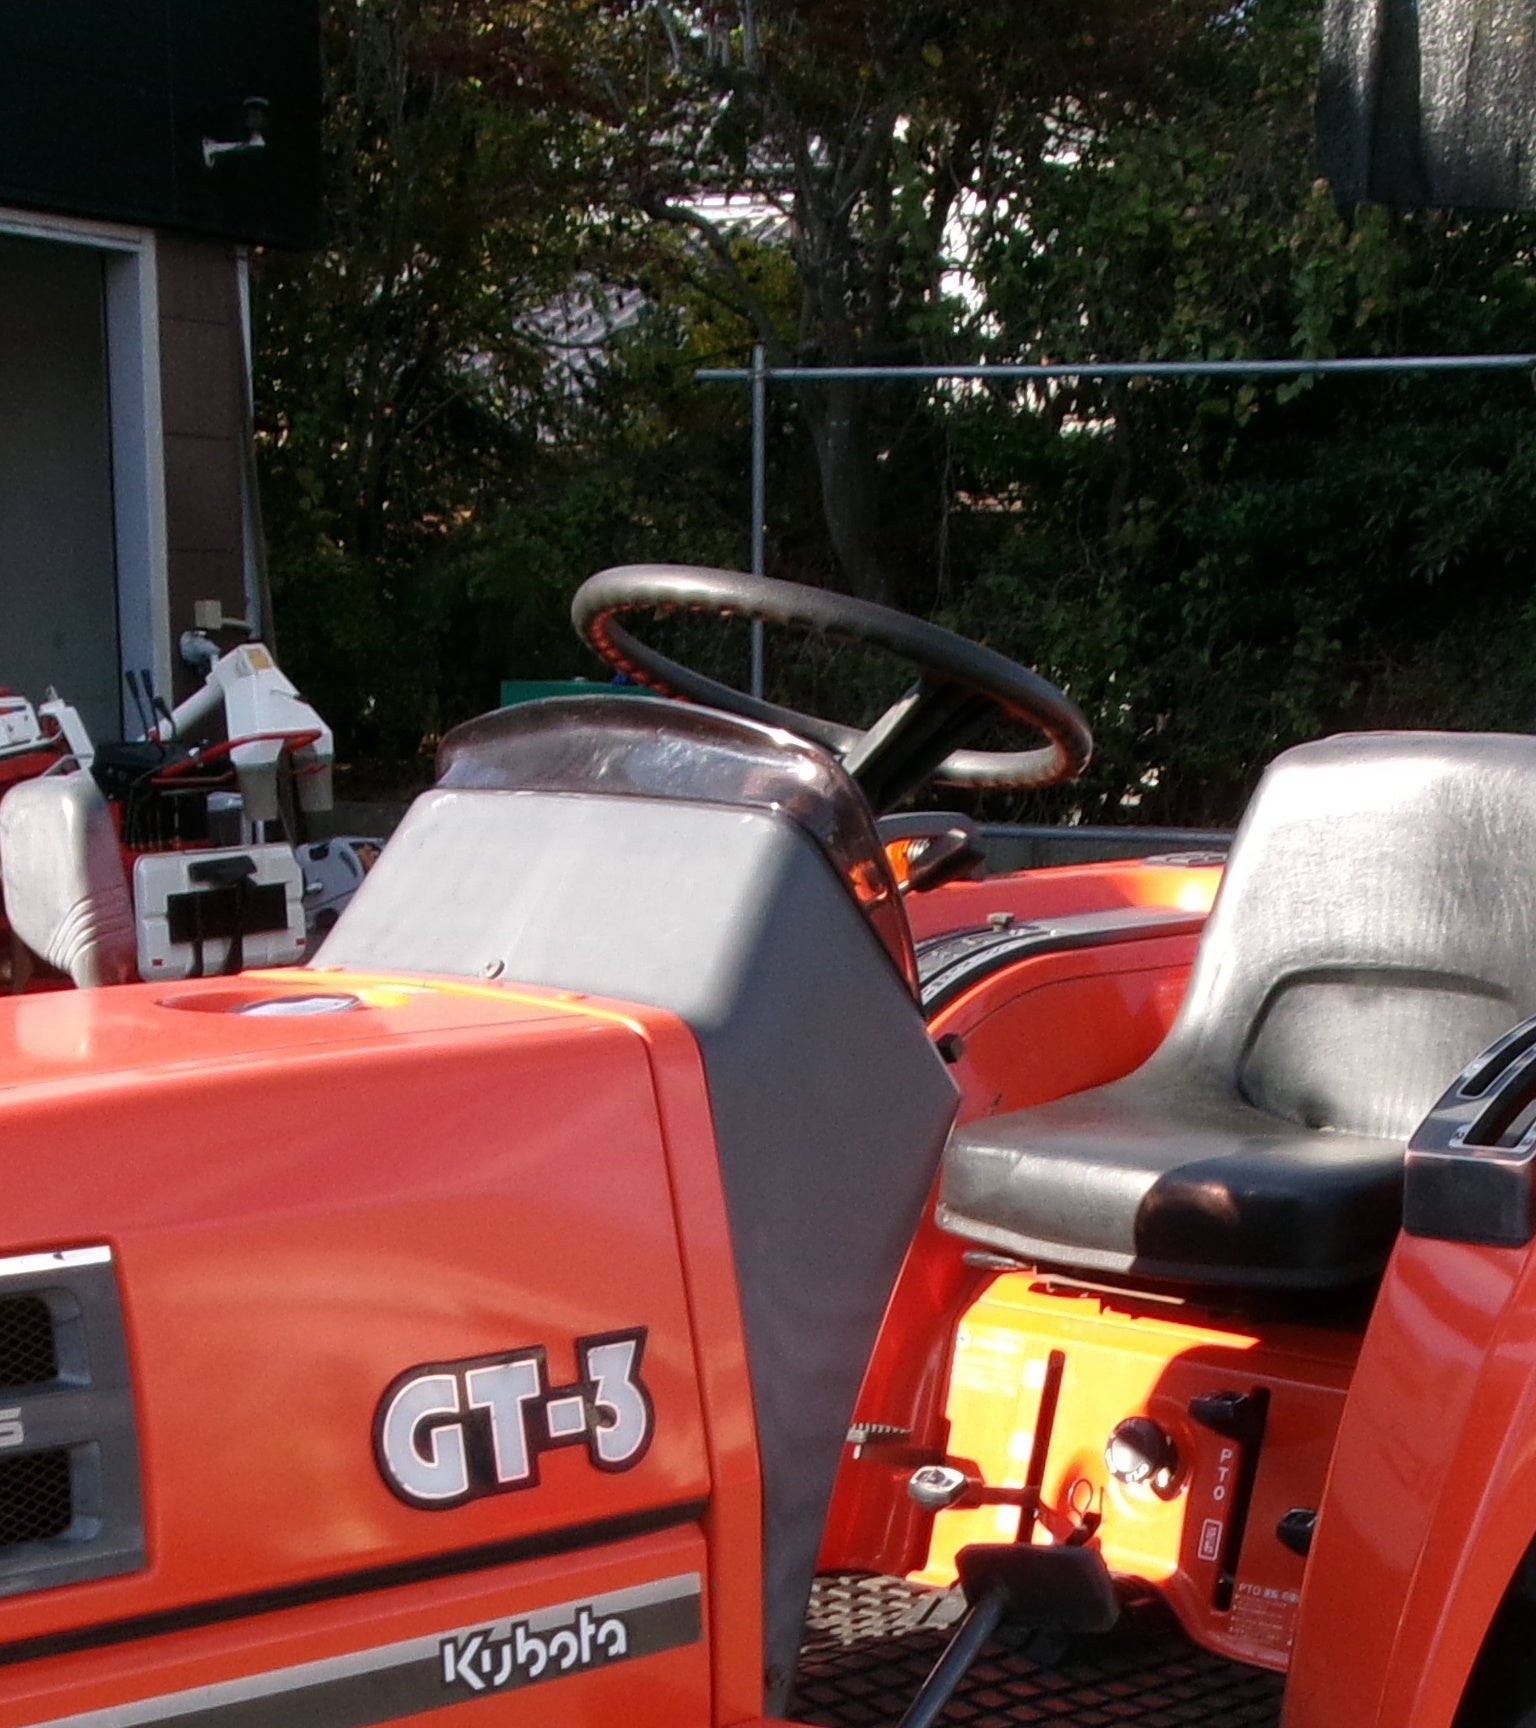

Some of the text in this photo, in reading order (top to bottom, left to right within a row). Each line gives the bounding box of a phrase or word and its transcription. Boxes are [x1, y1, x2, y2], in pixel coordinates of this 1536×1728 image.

[379, 1336, 650, 1503] GT-3
[1212, 1447, 1233, 1501] PTO
[442, 1610, 628, 1691] Kubota
